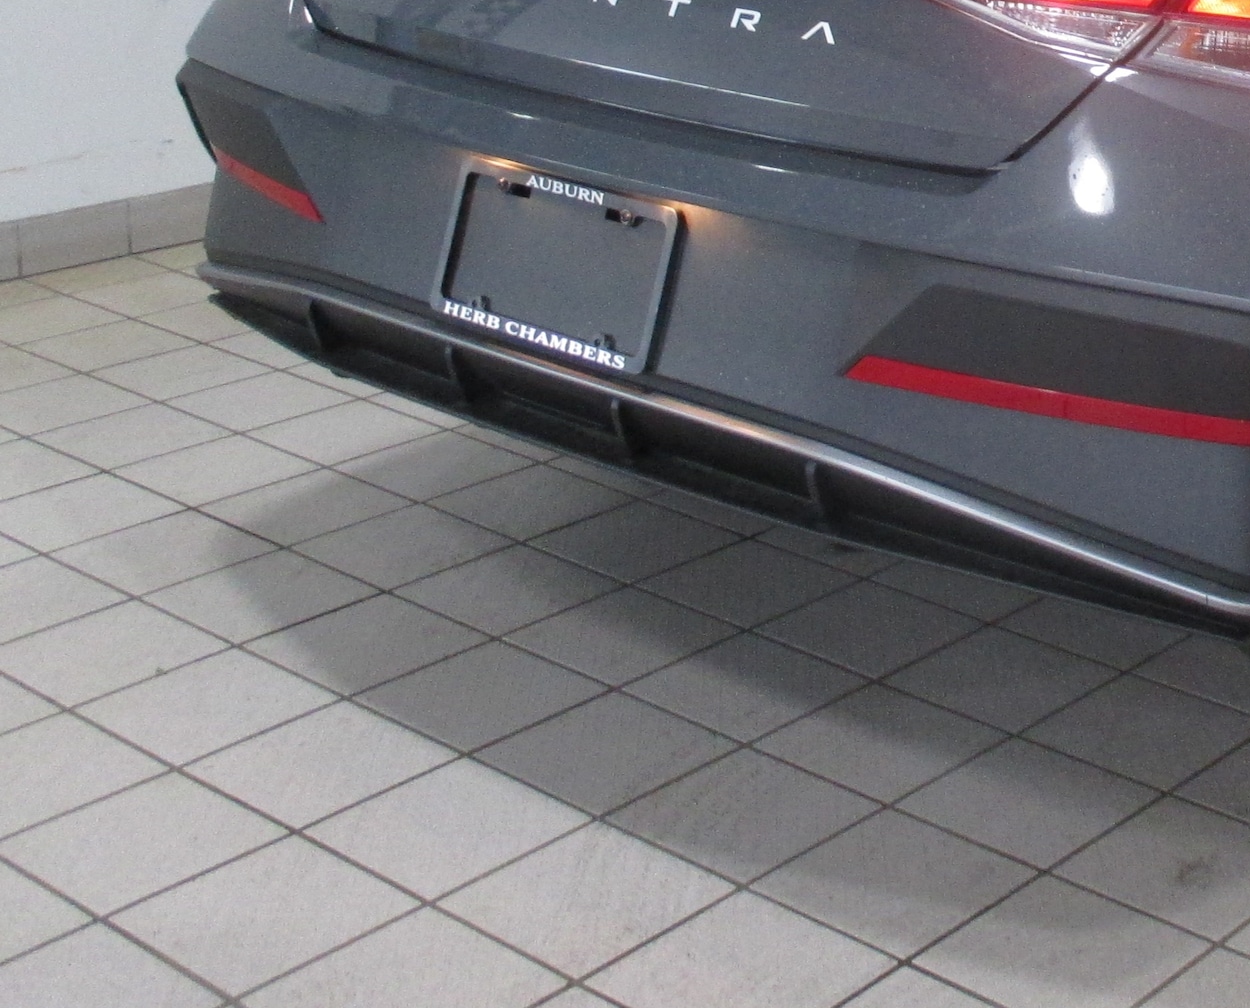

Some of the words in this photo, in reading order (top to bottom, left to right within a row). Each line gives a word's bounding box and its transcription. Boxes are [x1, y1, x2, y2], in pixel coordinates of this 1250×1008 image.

[526, 175, 604, 205] AUBURN
[443, 301, 500, 329] HERB
[505, 321, 626, 370] CHAMBERS
